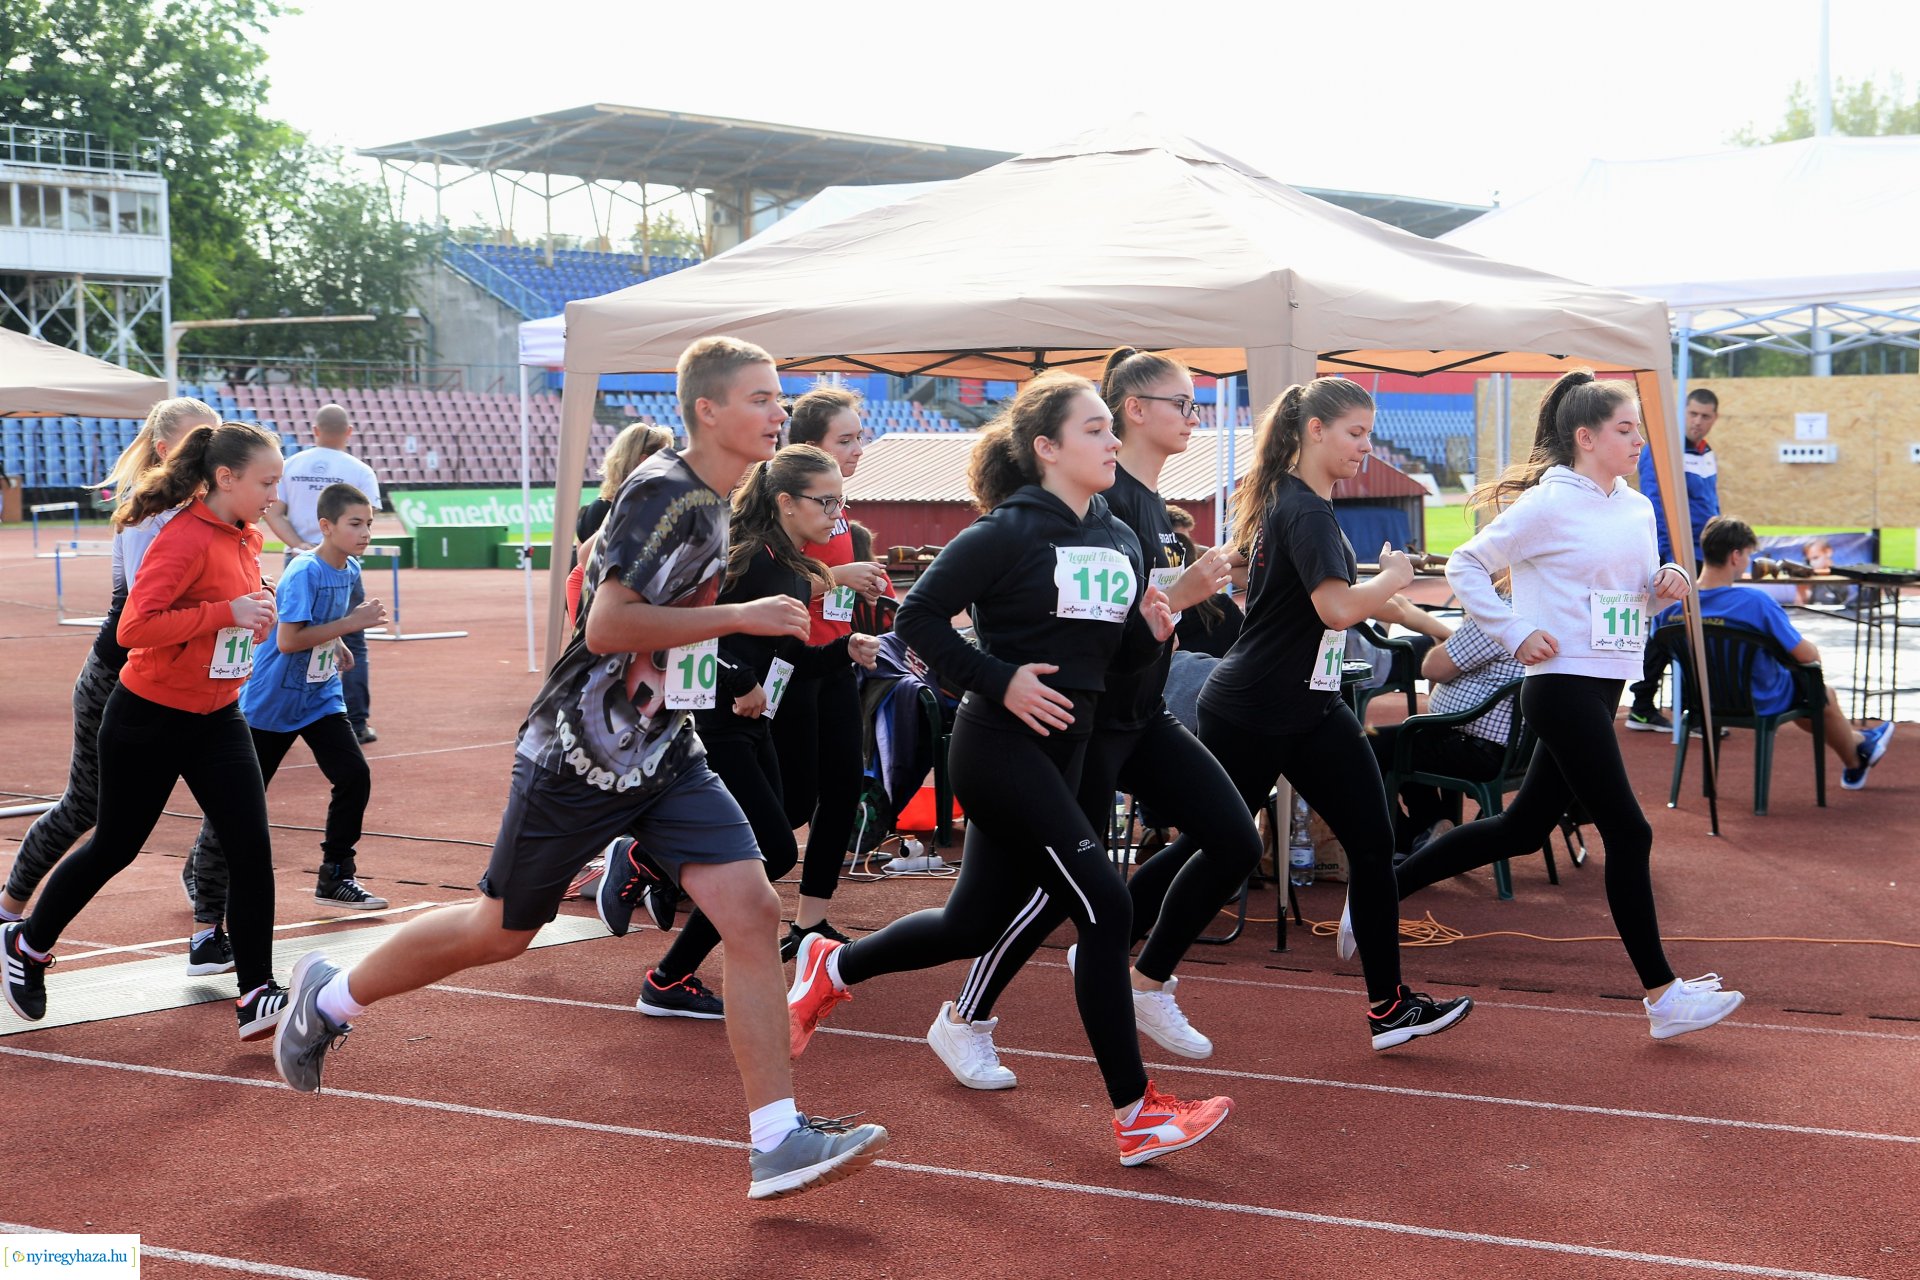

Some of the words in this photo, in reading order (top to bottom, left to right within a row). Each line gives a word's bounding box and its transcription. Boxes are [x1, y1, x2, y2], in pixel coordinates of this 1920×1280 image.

[439, 496, 556, 525] merkanti
[1158, 532, 1178, 544] smart
[516, 549, 525, 570] 3
[1073, 567, 1130, 606] 112
[1603, 607, 1640, 637] 111
[225, 635, 253, 664] 11
[1324, 647, 1344, 676] 11
[677, 653, 716, 690] 10
